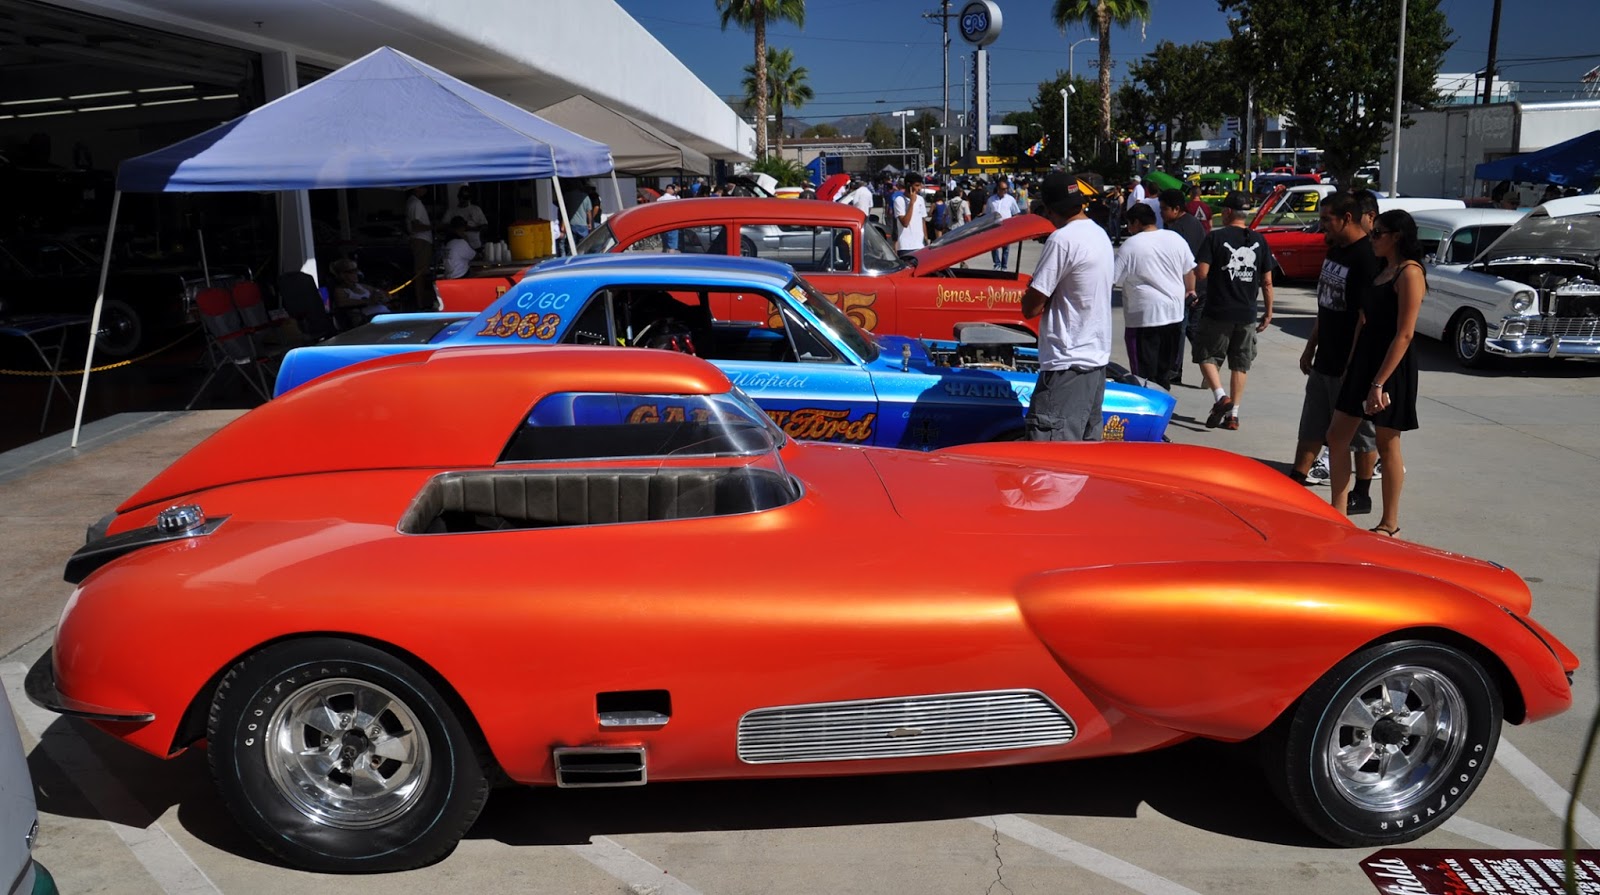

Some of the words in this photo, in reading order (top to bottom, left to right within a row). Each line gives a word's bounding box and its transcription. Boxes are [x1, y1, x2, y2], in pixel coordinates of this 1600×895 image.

[1228, 266, 1254, 281] Voodoo
[517, 292, 570, 310] C/GC
[936, 284, 975, 308] Jones
[476, 308, 561, 340] 1968
[723, 370, 809, 391] Winfield
[780, 407, 877, 441] Ford
[245, 667, 348, 747] GOODYEAR
[612, 717, 656, 725] STEP
[1380, 744, 1483, 830] GOODYEAR
[1444, 858, 1463, 872] CAR
[1469, 858, 1506, 891] WINFIELD
[1506, 858, 1543, 888] WINFIELD
